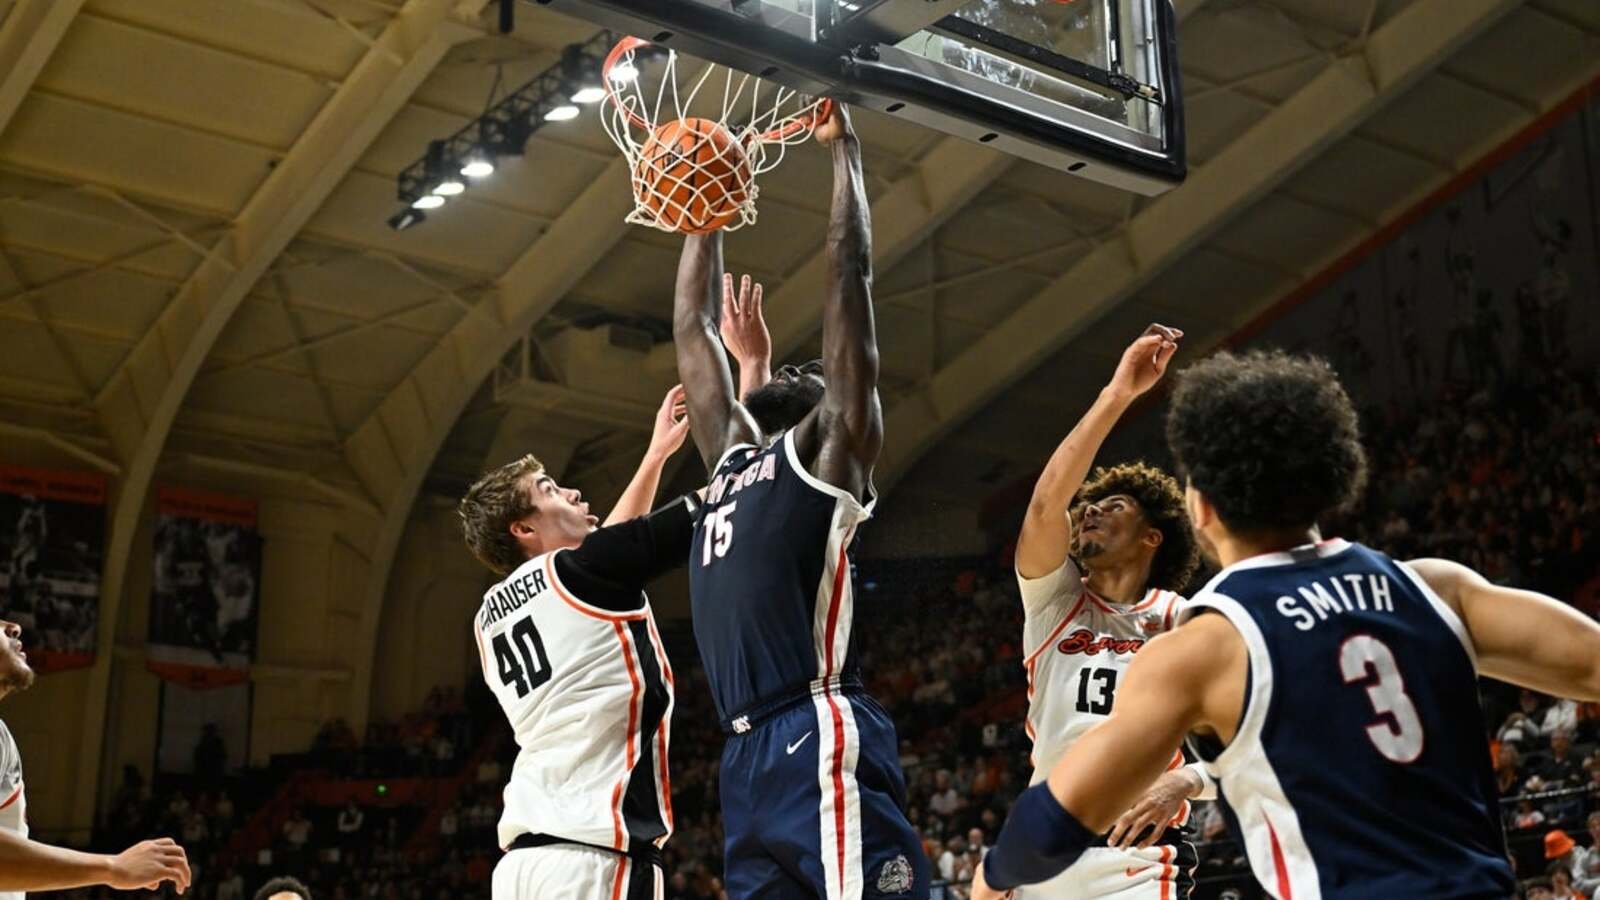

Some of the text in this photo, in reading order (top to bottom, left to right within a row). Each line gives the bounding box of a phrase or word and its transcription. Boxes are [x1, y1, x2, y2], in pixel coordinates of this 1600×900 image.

[702, 500, 737, 567] 15
[1276, 574, 1394, 631] SMITH
[492, 615, 552, 699] 40
[1076, 667, 1118, 716] 13
[1340, 634, 1424, 764] 3
